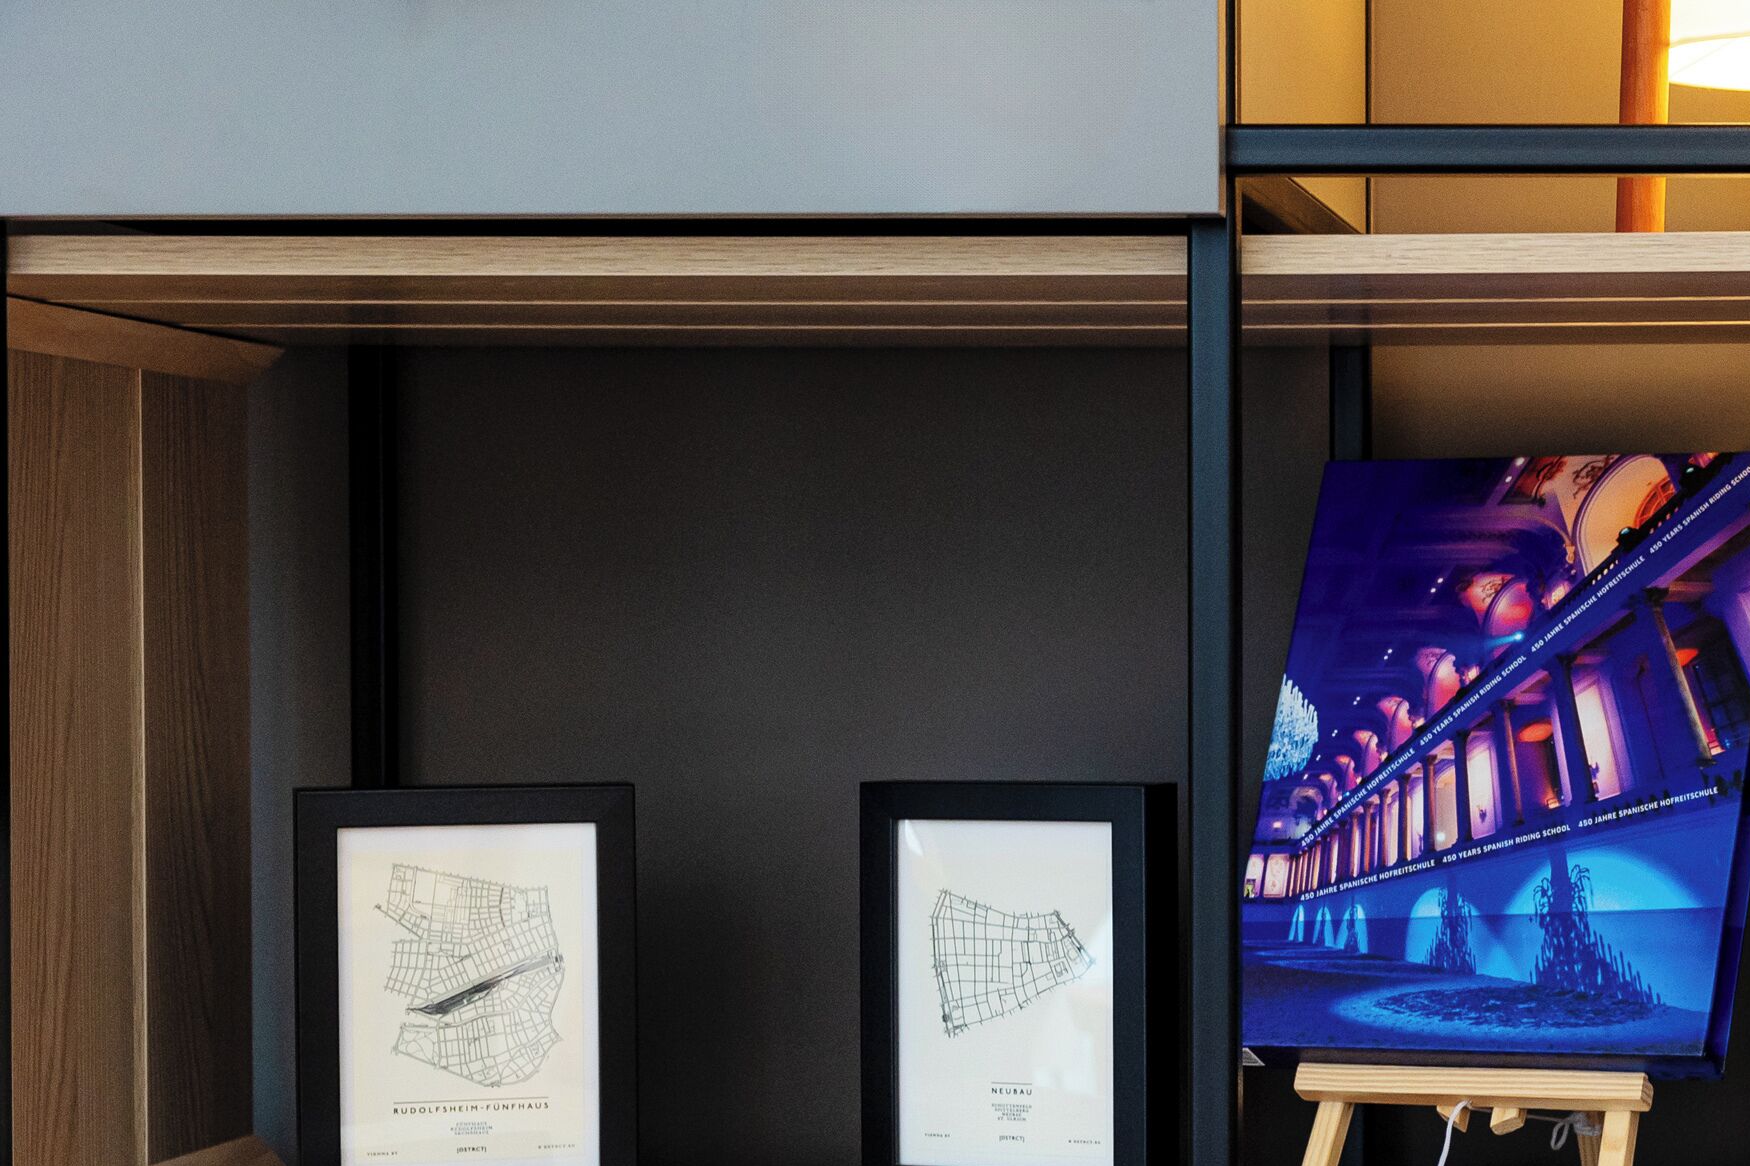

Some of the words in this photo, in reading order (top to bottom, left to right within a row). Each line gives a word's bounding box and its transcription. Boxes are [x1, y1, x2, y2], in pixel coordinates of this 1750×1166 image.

[1301, 834, 1314, 847] 450
[1314, 818, 1334, 836] JAHRE
[1333, 789, 1367, 819] SPANISCHE
[1366, 748, 1415, 793] HOFREITSCHULE
[1419, 733, 1433, 746] 450
[1432, 716, 1454, 735] YEARS
[1452, 693, 1480, 718] SPANISH
[1479, 676, 1502, 697] RIDING
[1502, 655, 1527, 680] SCHOOL
[1530, 639, 1544, 652] 450
[1544, 624, 1564, 642] JAHRE
[1563, 595, 1598, 625] SPANISCHE
[1596, 555, 1646, 598] HOFREITSCHULE
[1650, 541, 1664, 554] 450
[1662, 524, 1683, 543] YEARS
[1682, 501, 1710, 527] SPANISH
[1708, 484, 1732, 505] RIDING
[1300, 892, 1315, 902] 450
[1316, 885, 1338, 898] JAHRE
[1339, 874, 1378, 892] SPANISCHE
[1379, 858, 1436, 881] HOFREITSCHULE
[1442, 854, 1458, 864] 450
[1458, 847, 1482, 860] YEARS
[1483, 839, 1514, 854] SPANISH
[1515, 832, 1541, 845] RIDING
[1542, 824, 1571, 838] SCHOOL
[1578, 819, 1593, 828] 450
[1594, 811, 1618, 826] JAHRE
[1618, 801, 1660, 818] SPANISCHE
[1660, 786, 1719, 808] HOFREITSCHULE
[393, 1102, 549, 1115] RUDOLFSHEIM-FÜNFHAUS
[991, 1087, 1033, 1096] NEUBAU
